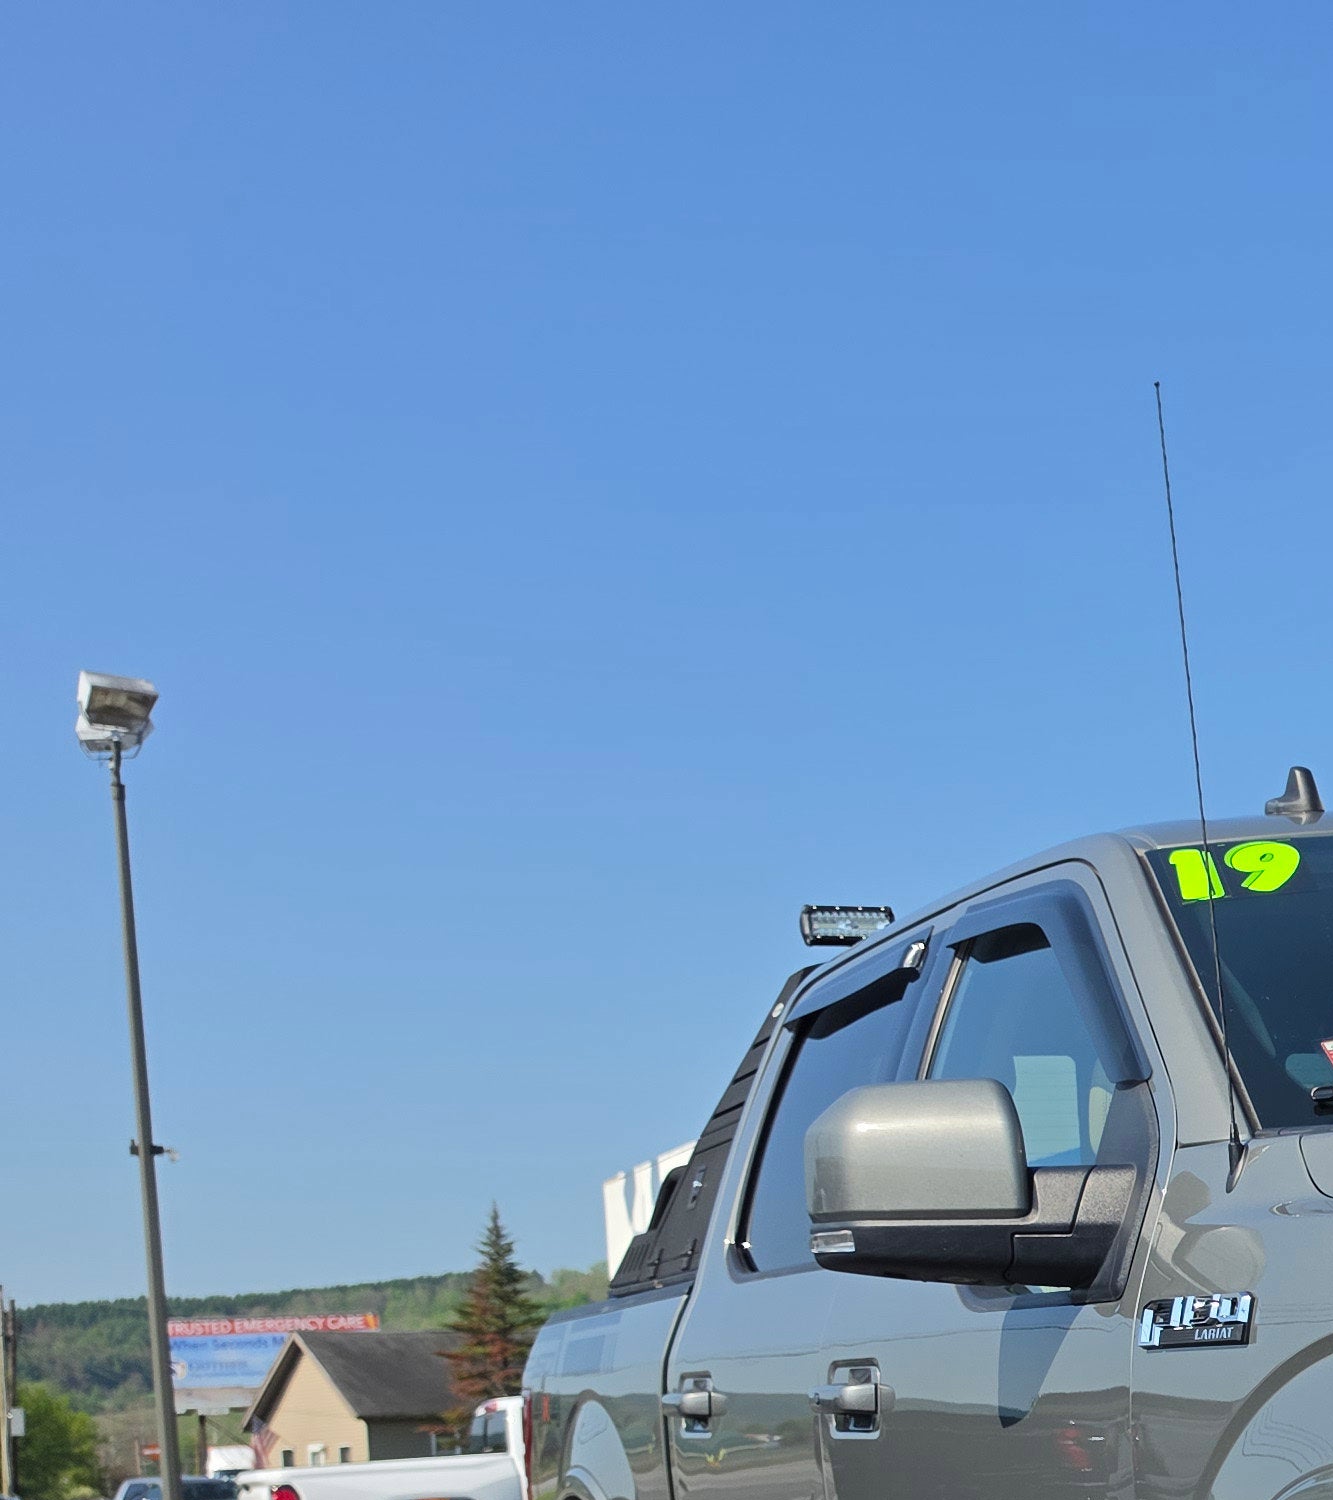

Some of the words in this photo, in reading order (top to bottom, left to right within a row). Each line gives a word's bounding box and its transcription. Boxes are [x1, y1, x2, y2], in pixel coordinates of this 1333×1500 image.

[1169, 841, 1301, 901] 19
[167, 1320, 233, 1336] TRUSTED
[235, 1315, 325, 1334] EMERGENCY
[327, 1314, 366, 1330] CARE
[1194, 1326, 1234, 1341] LARIAT
